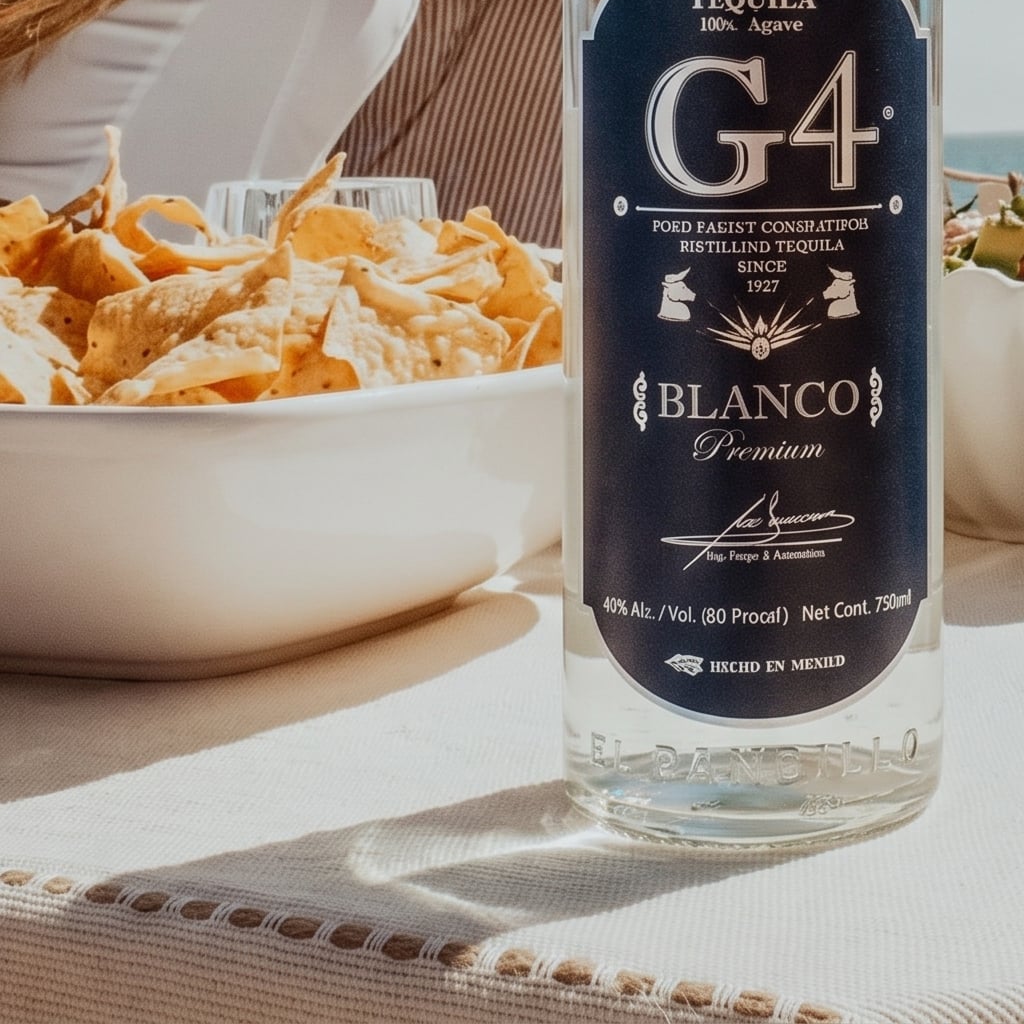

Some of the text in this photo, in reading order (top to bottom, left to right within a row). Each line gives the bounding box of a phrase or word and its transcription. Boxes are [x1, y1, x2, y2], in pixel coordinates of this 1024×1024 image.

[748, 16, 804, 36] Agave
[644, 50, 880, 198] G4
[680, 238, 845, 255] RISTILLIND TEQUILA
[737, 260, 787, 273] SINCE
[746, 279, 780, 293] 1927
[657, 379, 860, 420] BLANCO
[692, 428, 826, 462] Premium
[603, 596, 628, 616] 40%
[701, 607, 727, 626] (80
[802, 605, 830, 622] Net
[834, 599, 872, 619] Cont.
[766, 660, 785, 673] EN
